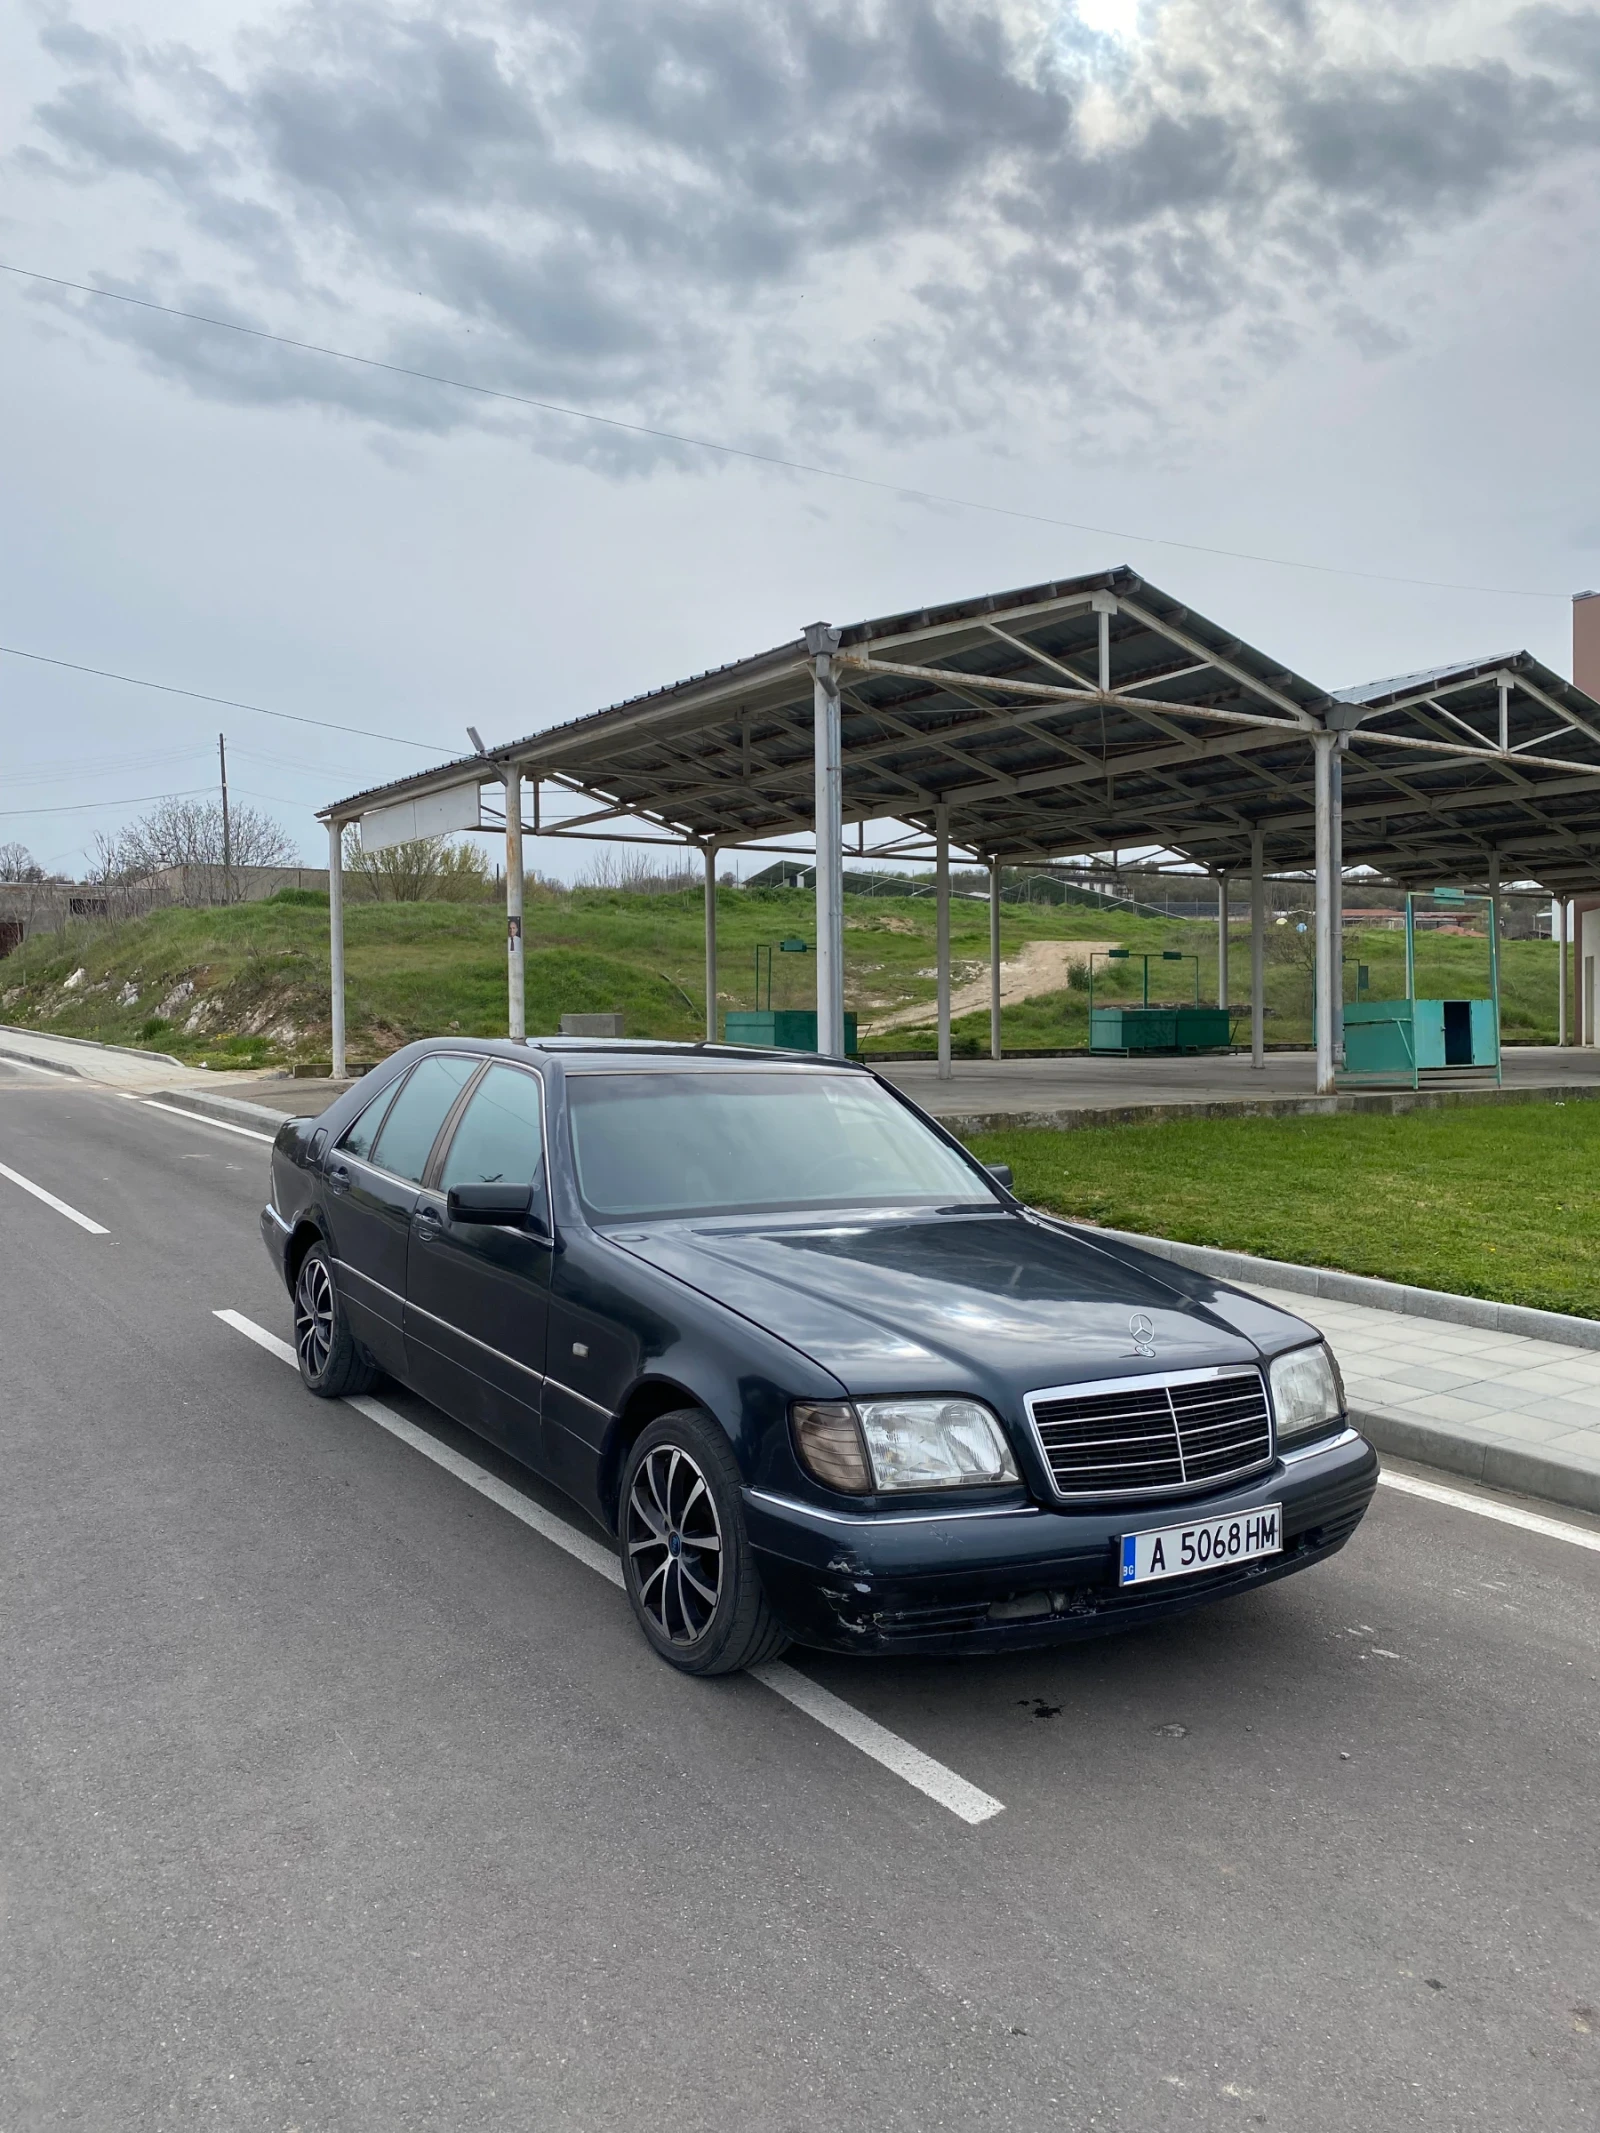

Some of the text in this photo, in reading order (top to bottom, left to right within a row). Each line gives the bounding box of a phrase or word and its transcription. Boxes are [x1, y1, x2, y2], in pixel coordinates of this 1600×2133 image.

[1150, 1513, 1275, 1573] A 5068 HM
